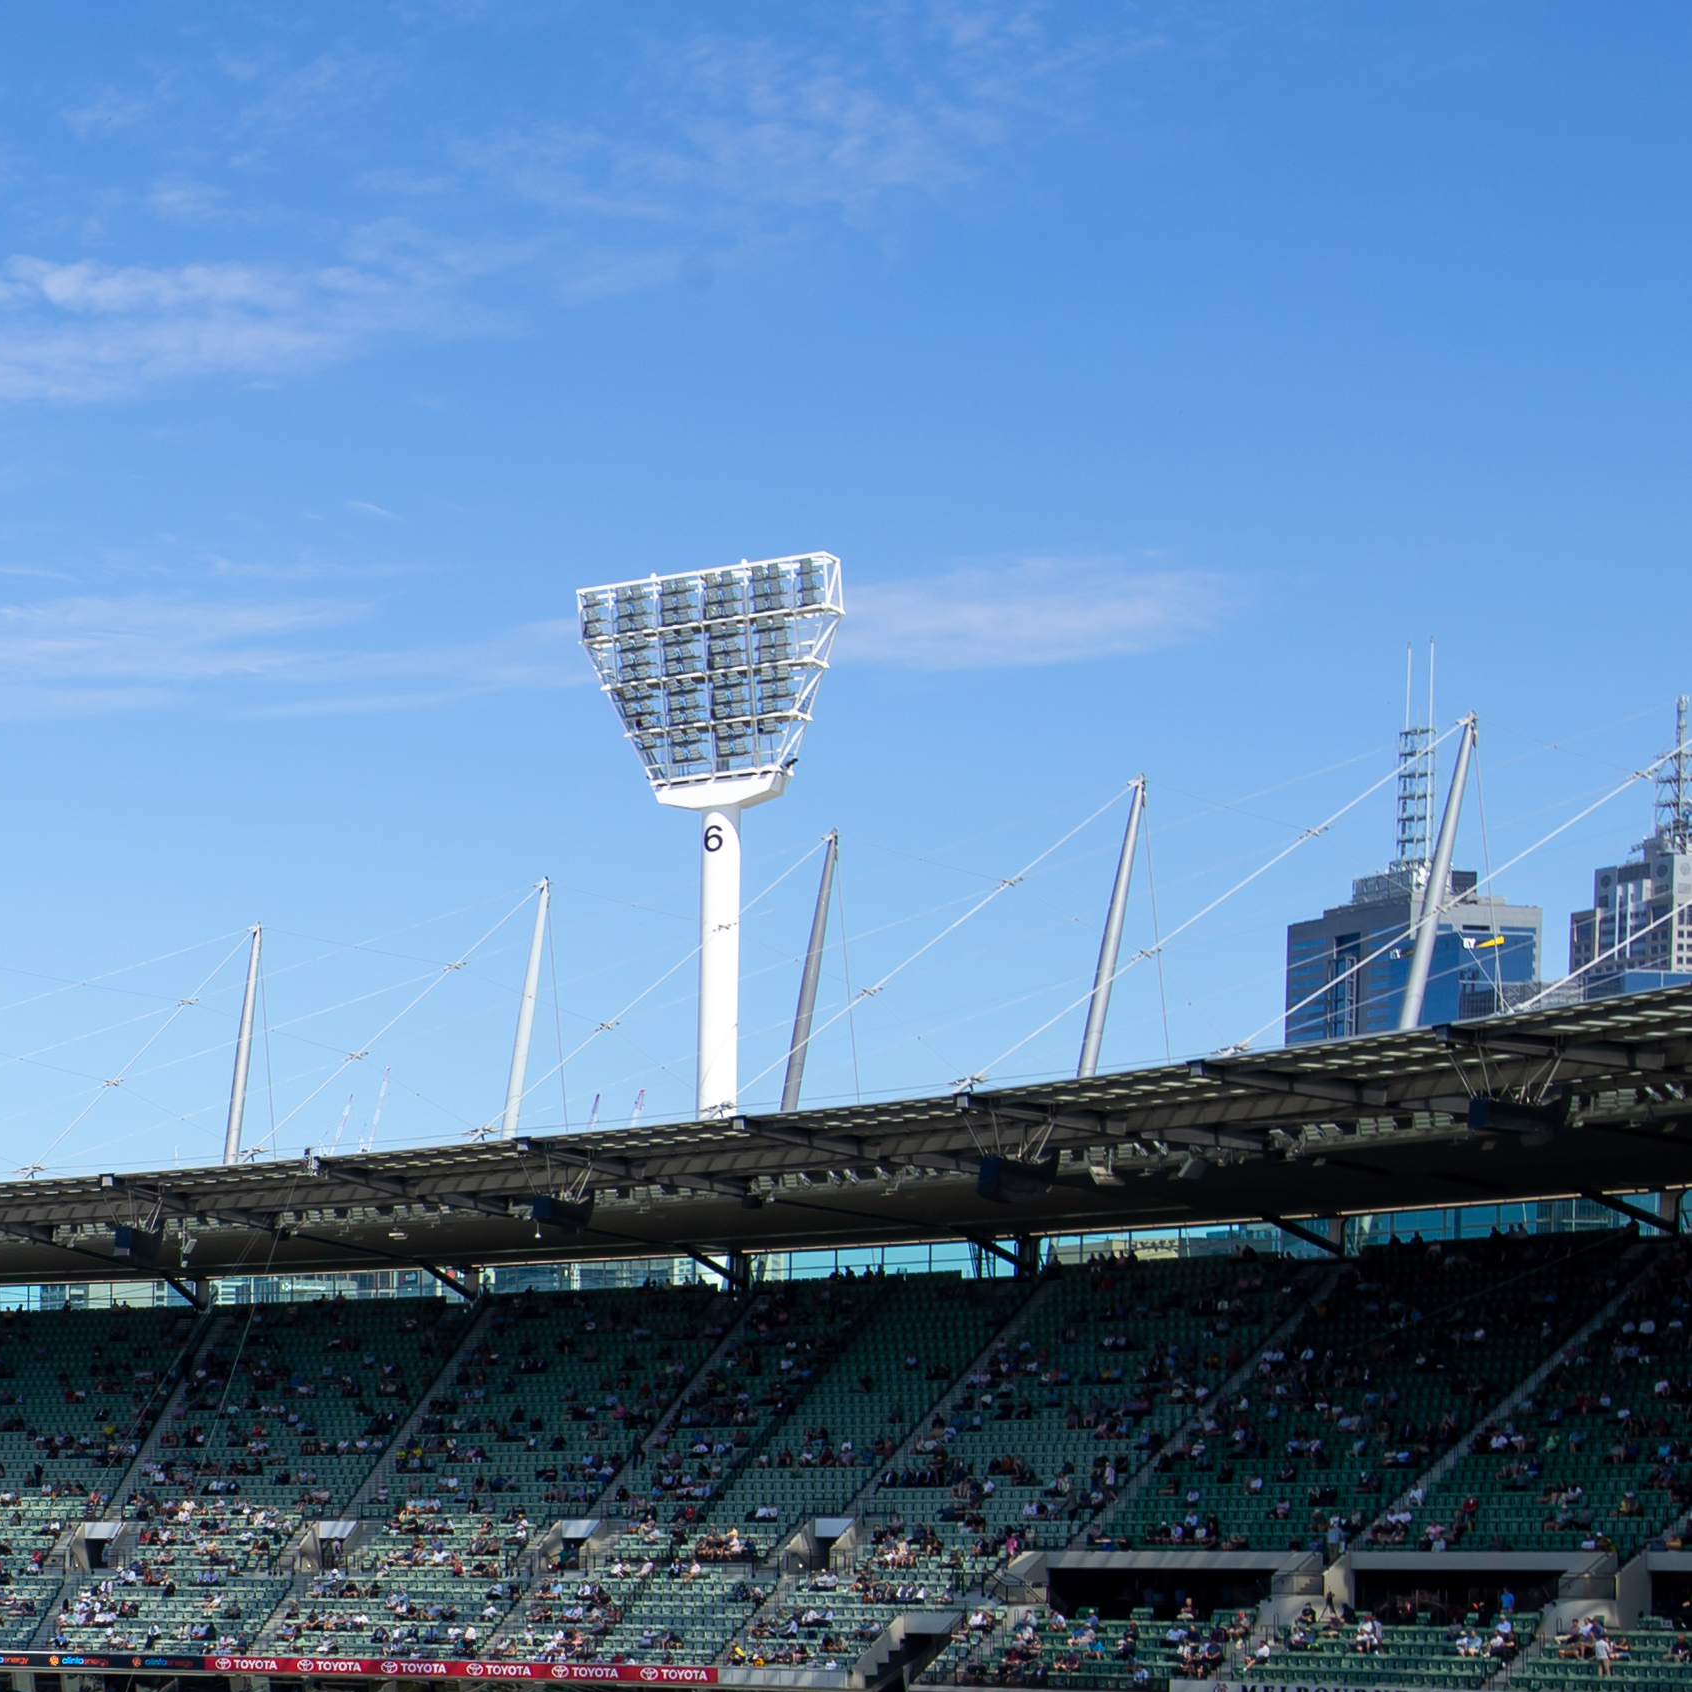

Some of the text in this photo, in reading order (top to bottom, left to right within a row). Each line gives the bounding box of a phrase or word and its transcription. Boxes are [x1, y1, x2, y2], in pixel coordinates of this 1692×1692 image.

[704, 825, 723, 852] 6
[233, 1660, 277, 1669] TOYOTA
[660, 1669, 707, 1680] TOYOTA
